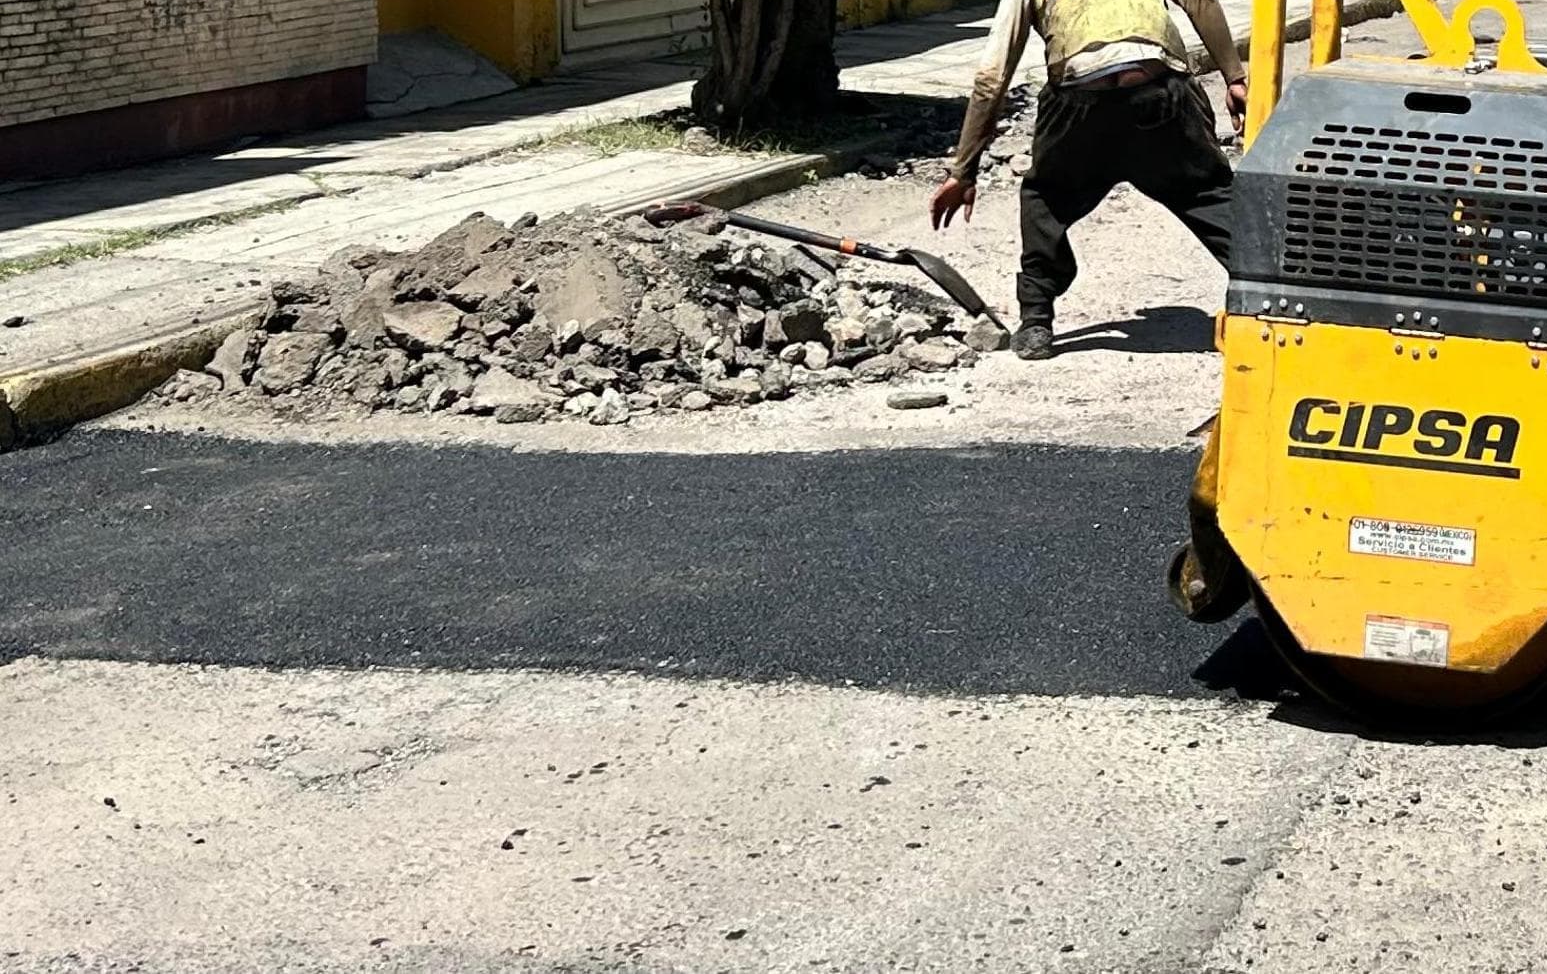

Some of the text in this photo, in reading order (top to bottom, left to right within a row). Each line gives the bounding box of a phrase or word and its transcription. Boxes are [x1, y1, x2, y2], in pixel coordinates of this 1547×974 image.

[1288, 397, 1521, 464] CIPSA
[1357, 535, 1467, 556] Servicio a Clientes
